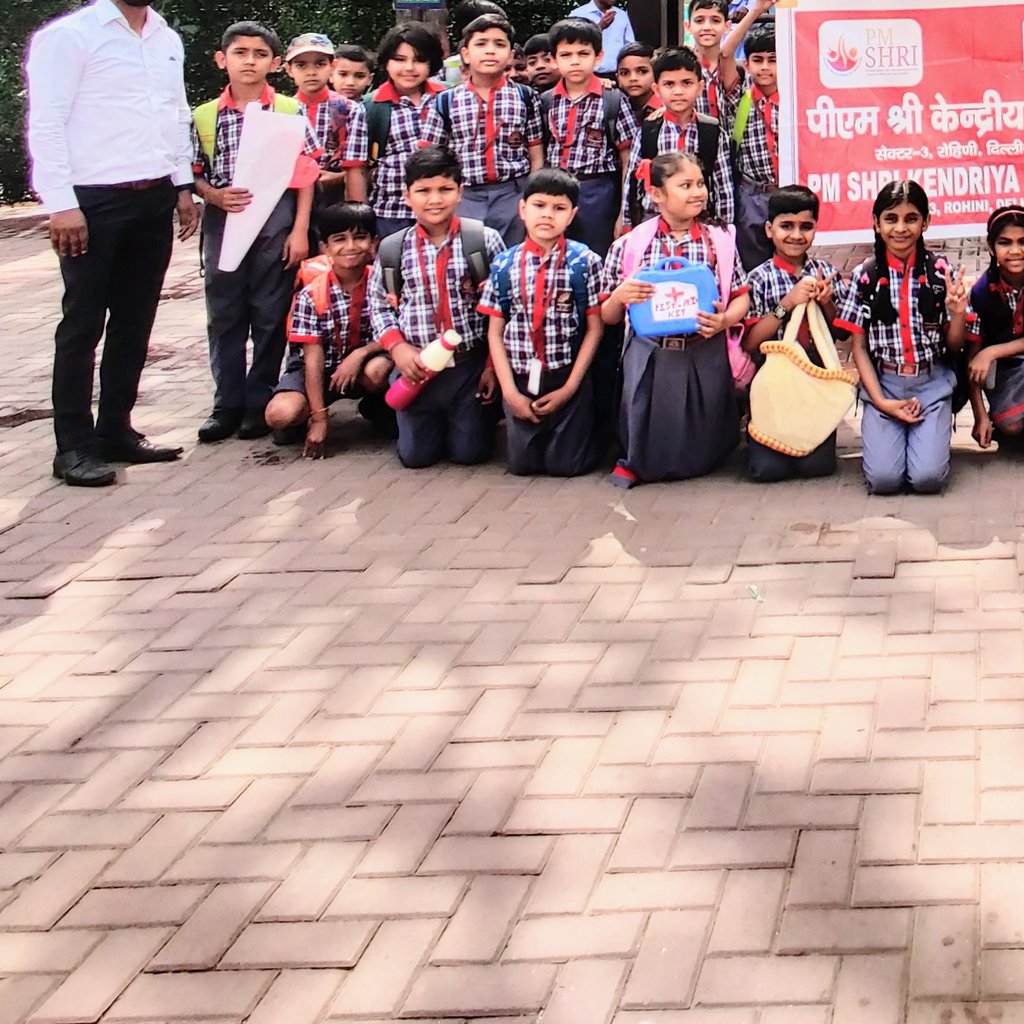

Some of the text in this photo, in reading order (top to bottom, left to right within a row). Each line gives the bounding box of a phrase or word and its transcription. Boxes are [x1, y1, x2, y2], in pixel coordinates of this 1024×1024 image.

[866, 28, 893, 46] PM
[865, 45, 918, 68] SHRI
[806, 95, 880, 140] पीएम
[886, 92, 924, 135] श्री
[807, 173, 841, 203] PM
[944, 199, 993, 214] ROHINI,
